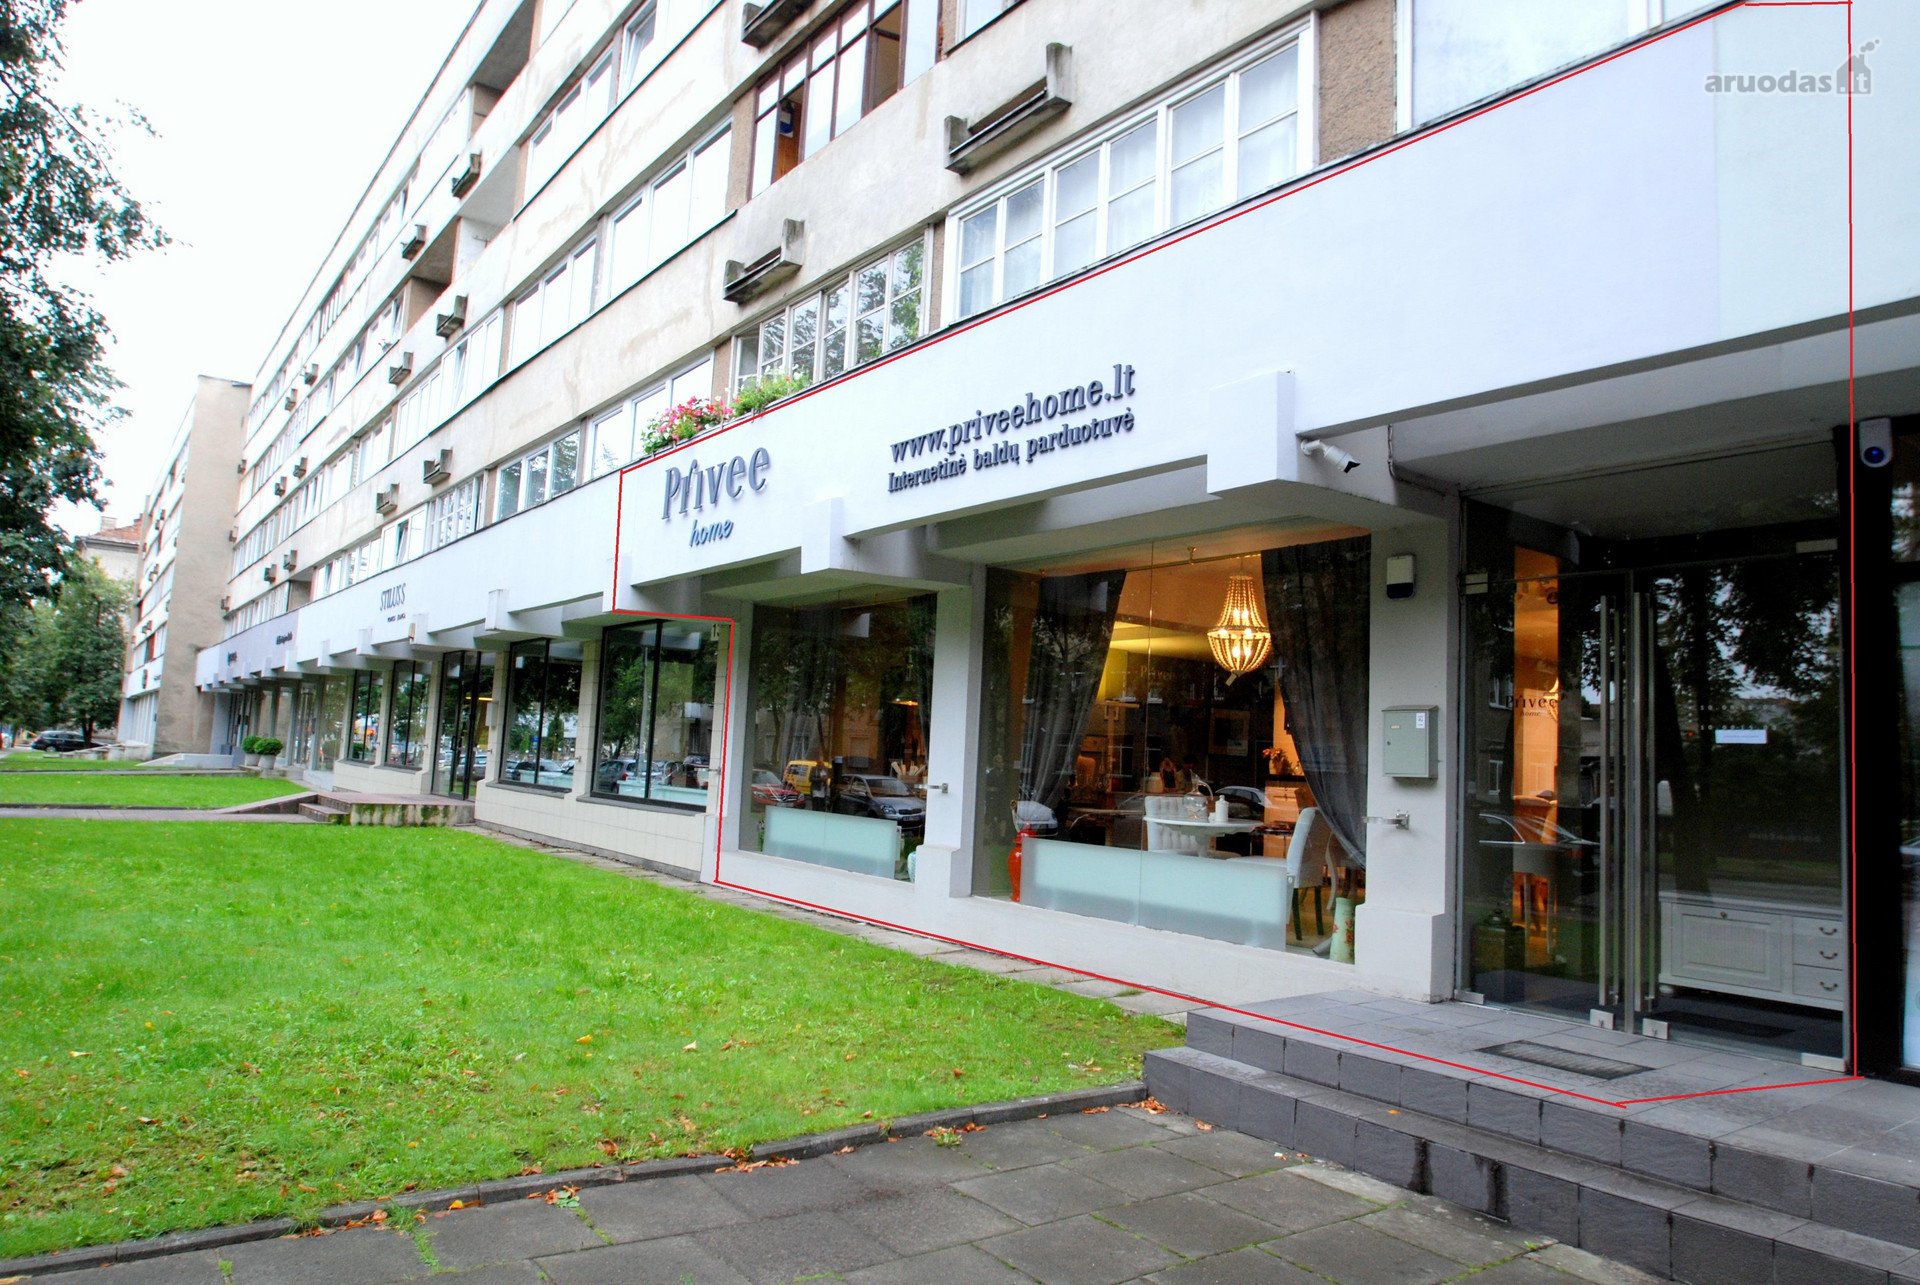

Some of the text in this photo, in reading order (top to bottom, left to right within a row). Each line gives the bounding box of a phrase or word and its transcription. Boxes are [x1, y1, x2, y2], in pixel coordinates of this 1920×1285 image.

[887, 406, 1136, 493] Internetinė baldų parduotuvė
[890, 363, 1136, 463] www.priveehome.lt
[689, 519, 735, 547] home
